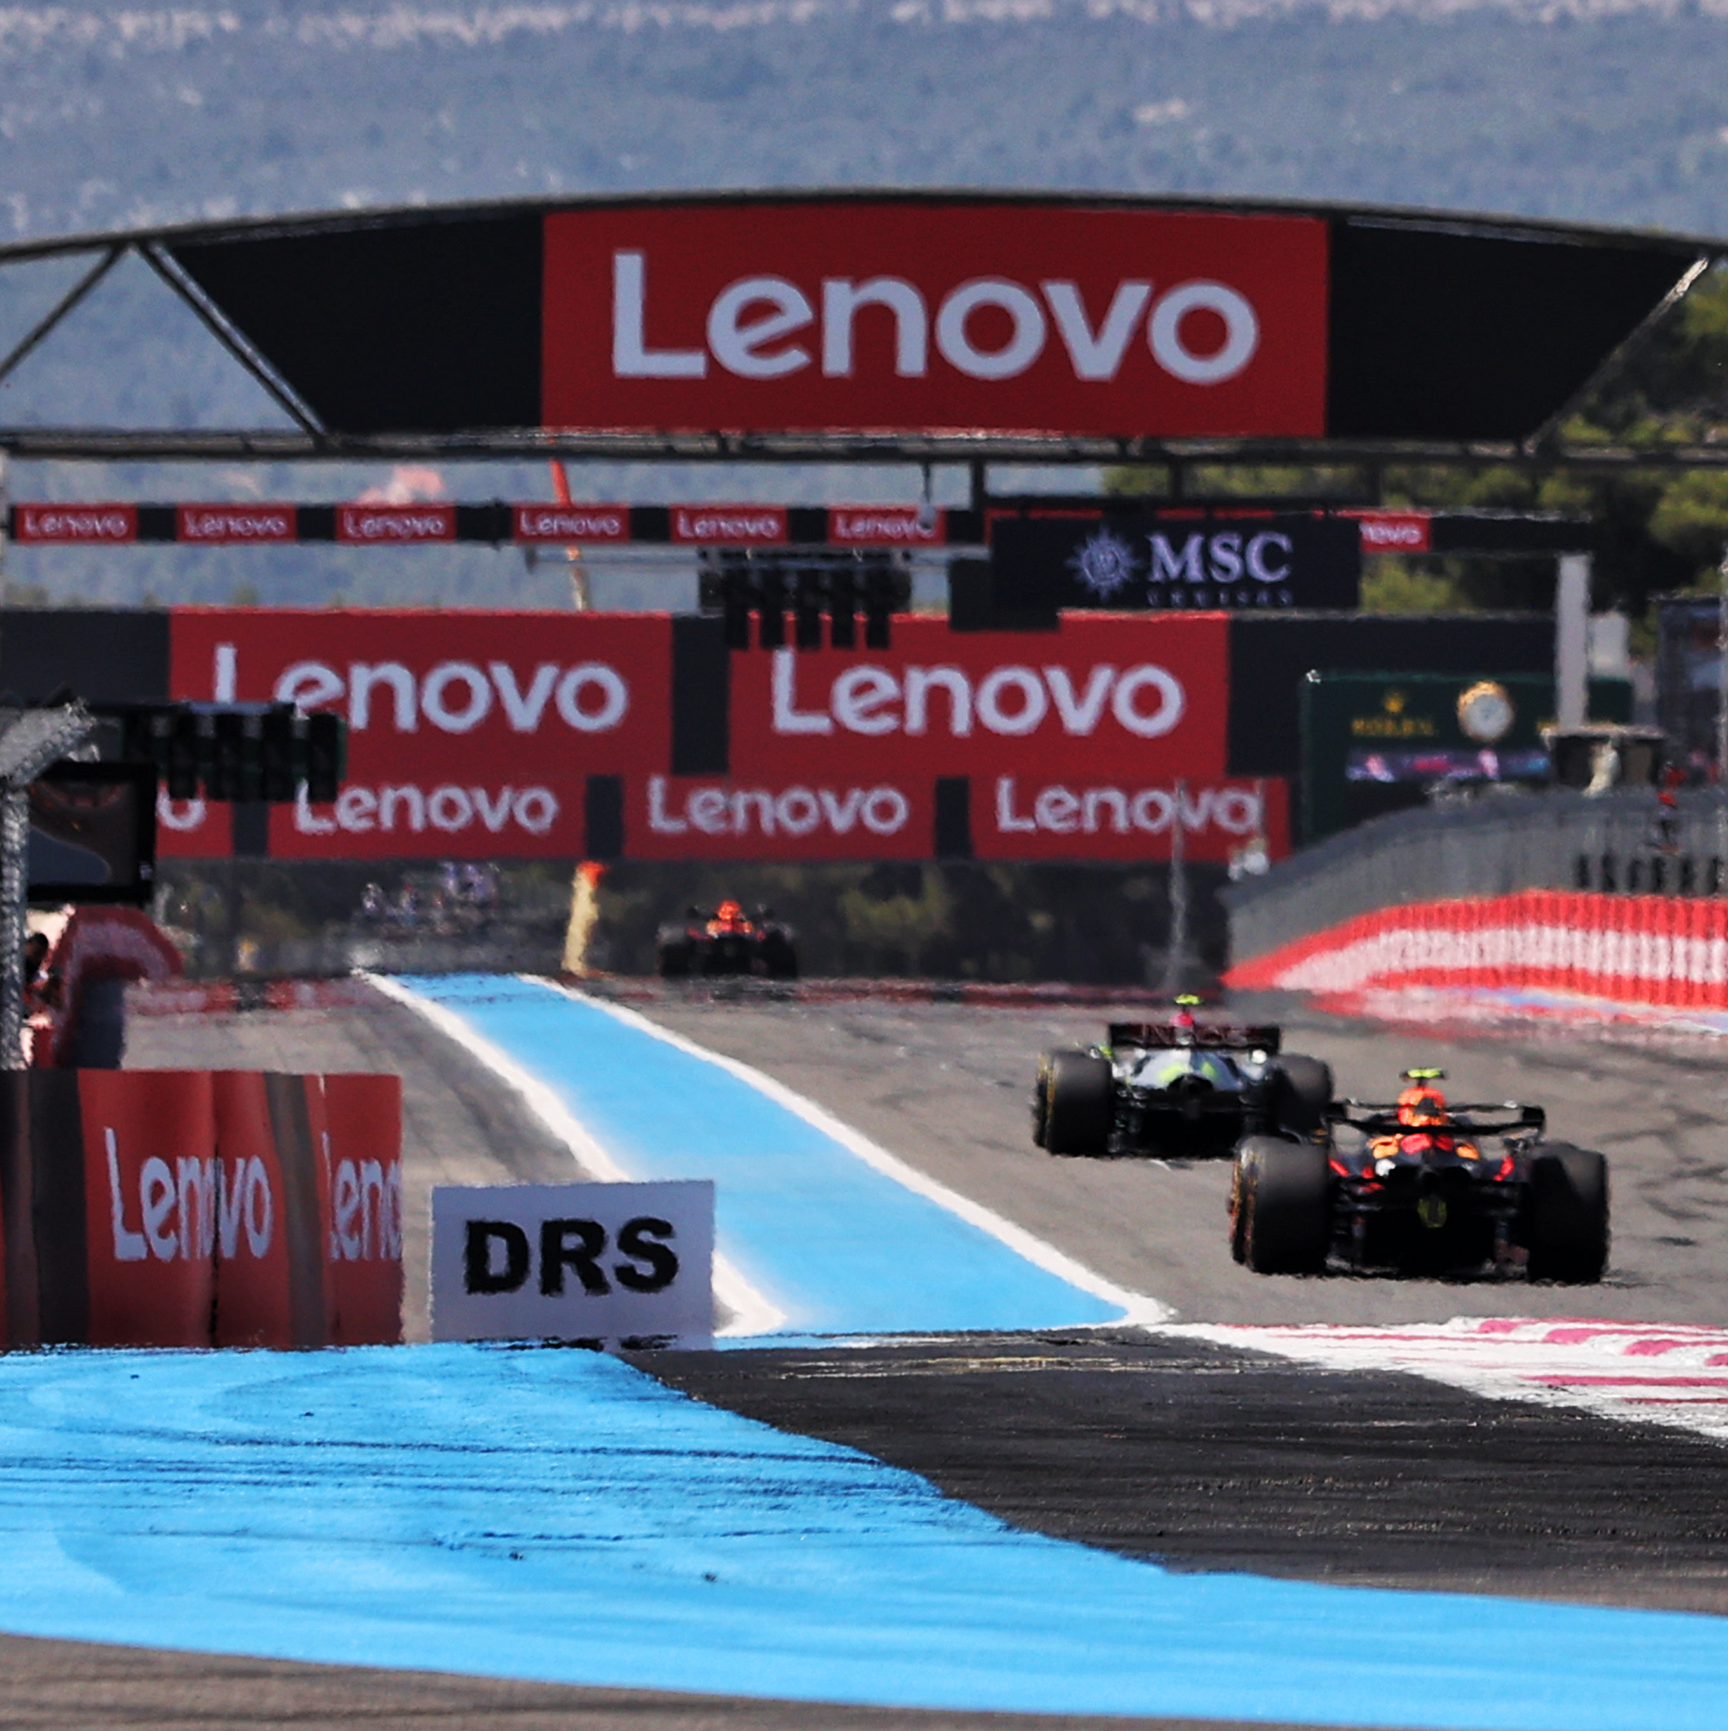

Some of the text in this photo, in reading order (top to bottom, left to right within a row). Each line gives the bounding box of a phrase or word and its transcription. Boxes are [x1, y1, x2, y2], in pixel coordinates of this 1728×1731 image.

[612, 250, 1259, 384] Lenovo
[25, 509, 128, 538] Lenovo
[520, 510, 621, 537] Lenovo
[1147, 531, 1293, 584] MSC
[772, 647, 1185, 737] Lenovo
[295, 777, 559, 834] Lenovo
[647, 776, 908, 835] Lenovo
[997, 776, 1262, 834] Lenovo
[467, 1218, 679, 1296] DRS
